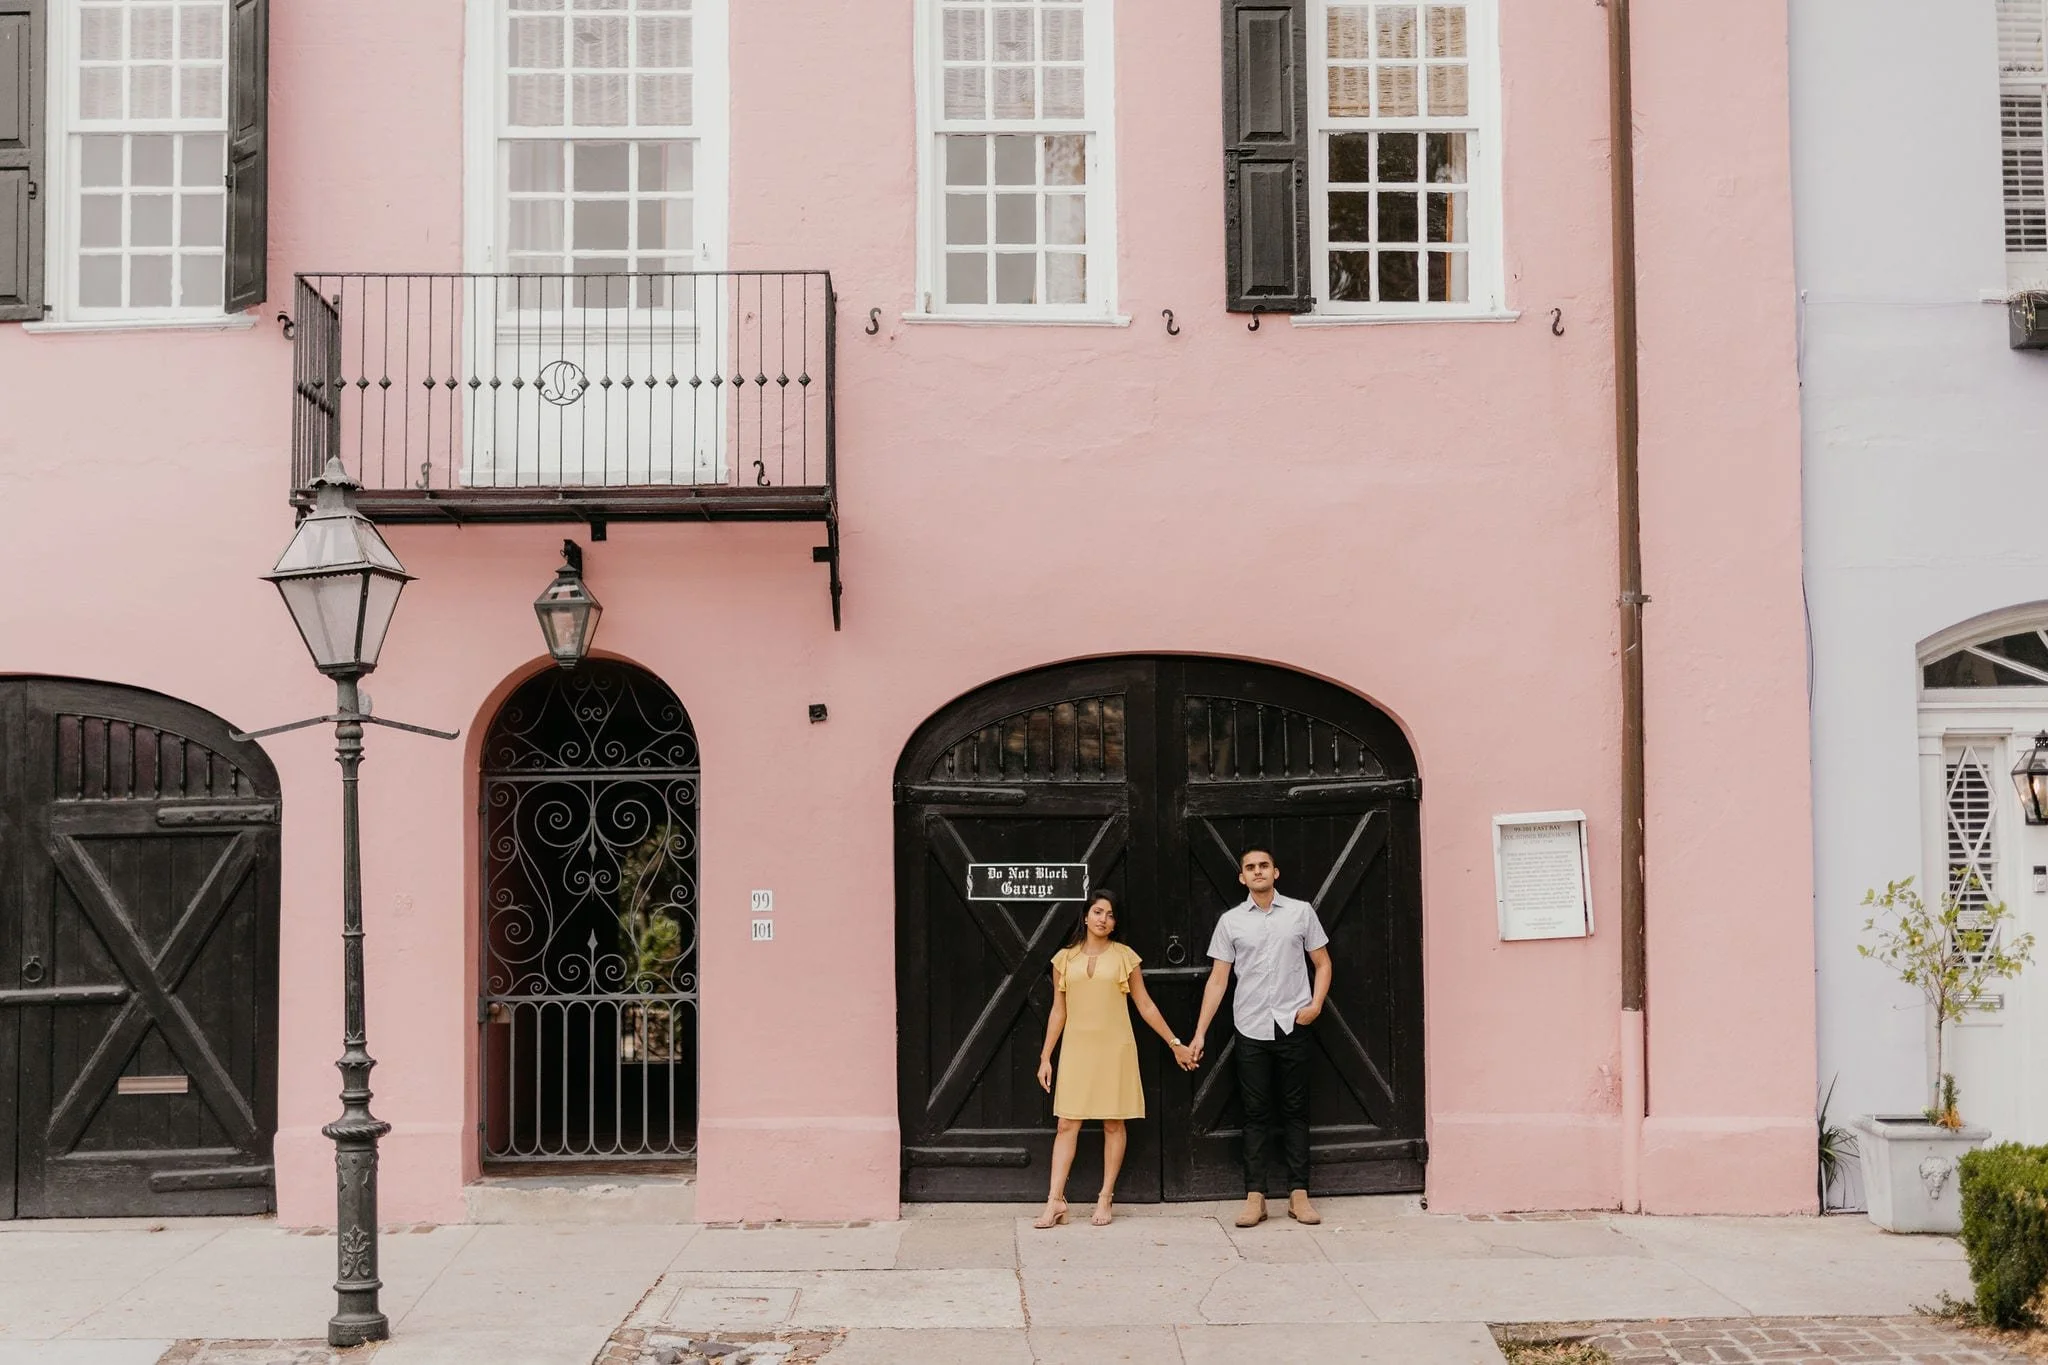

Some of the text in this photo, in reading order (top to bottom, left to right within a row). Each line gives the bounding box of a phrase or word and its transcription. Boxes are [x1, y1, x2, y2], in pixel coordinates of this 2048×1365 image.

[987, 867, 1068, 879] Do Not Block
[1001, 881, 1054, 898] Garage
[753, 892, 770, 909] 99
[754, 922, 771, 938] 101
